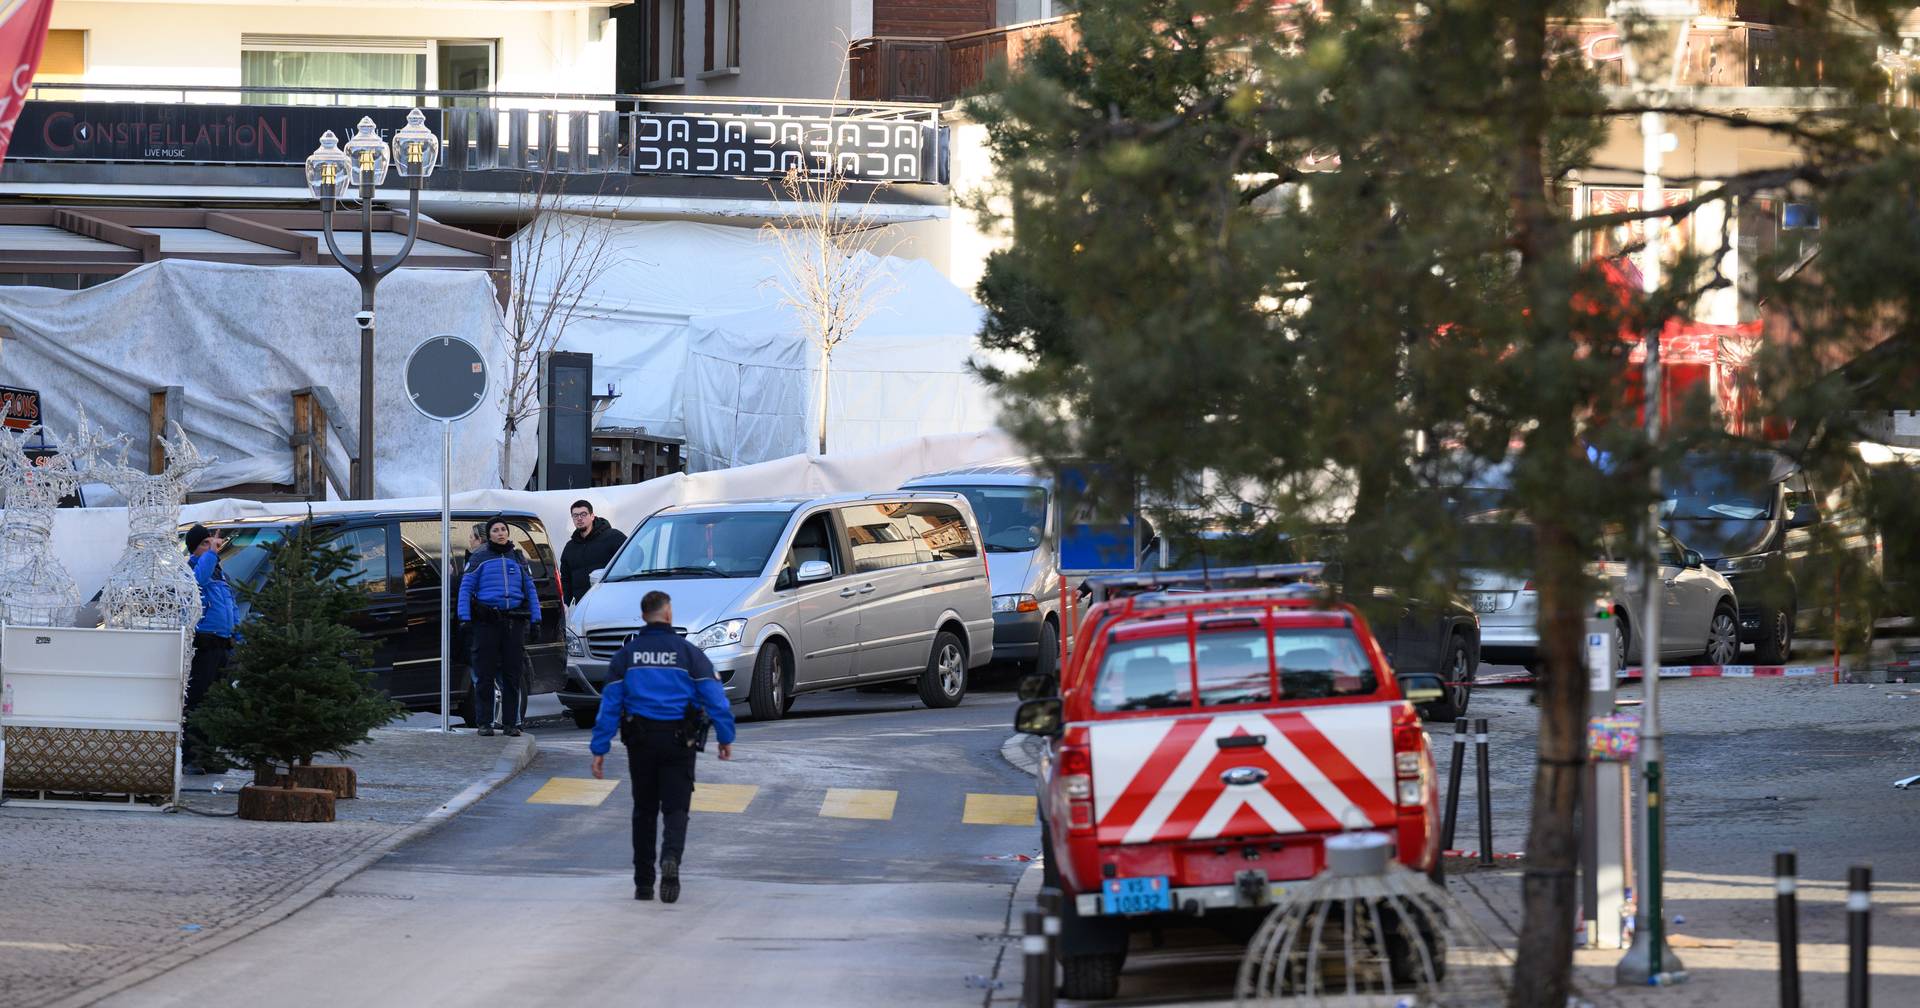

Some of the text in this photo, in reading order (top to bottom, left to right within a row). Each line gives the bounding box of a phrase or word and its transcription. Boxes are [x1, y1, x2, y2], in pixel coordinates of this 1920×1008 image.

[144, 148, 185, 157] LIVE MUSIC
[0, 392, 38, 418] TIONS
[633, 652, 677, 664] POLICE
